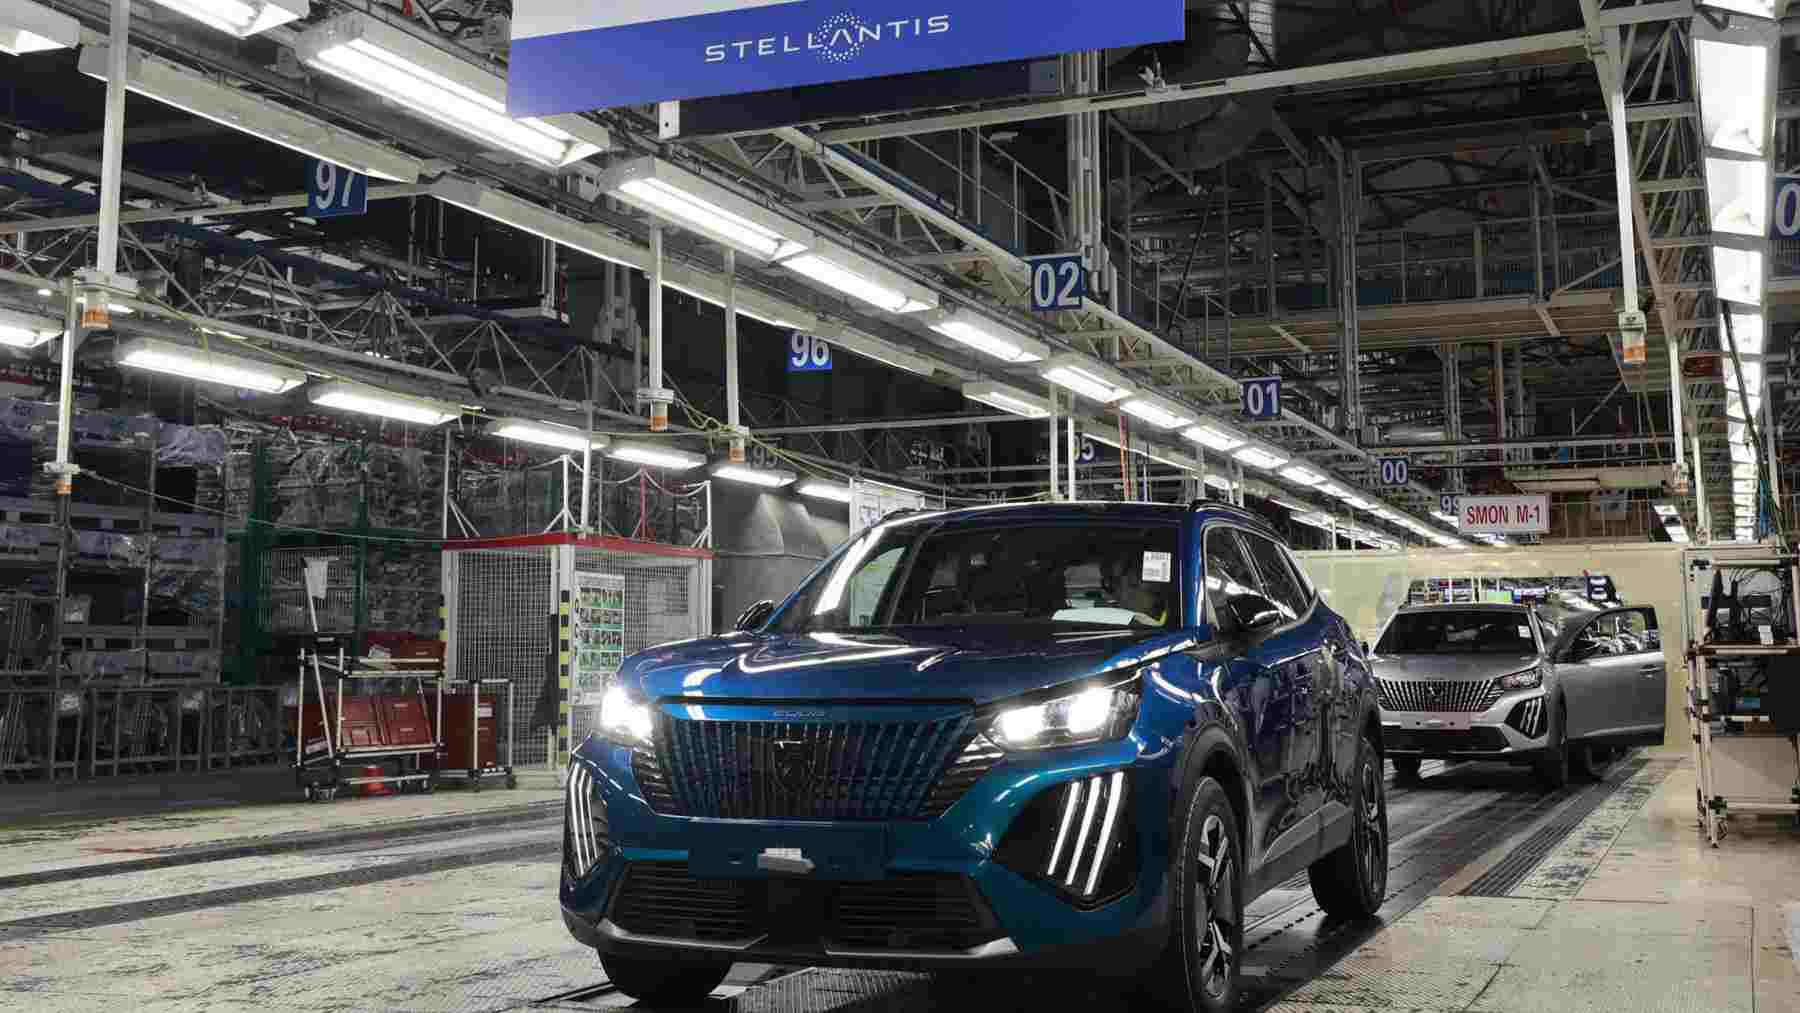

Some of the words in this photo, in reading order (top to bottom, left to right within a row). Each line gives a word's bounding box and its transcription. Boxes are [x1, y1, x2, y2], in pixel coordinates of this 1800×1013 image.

[705, 15, 950, 63] STELLANTIS
[1034, 261, 1081, 307] 02
[791, 330, 830, 367] 96
[1247, 382, 1278, 415] 01
[1382, 460, 1407, 484] 00
[1466, 505, 1508, 524] SMON
[1517, 504, 1540, 524] M-1
